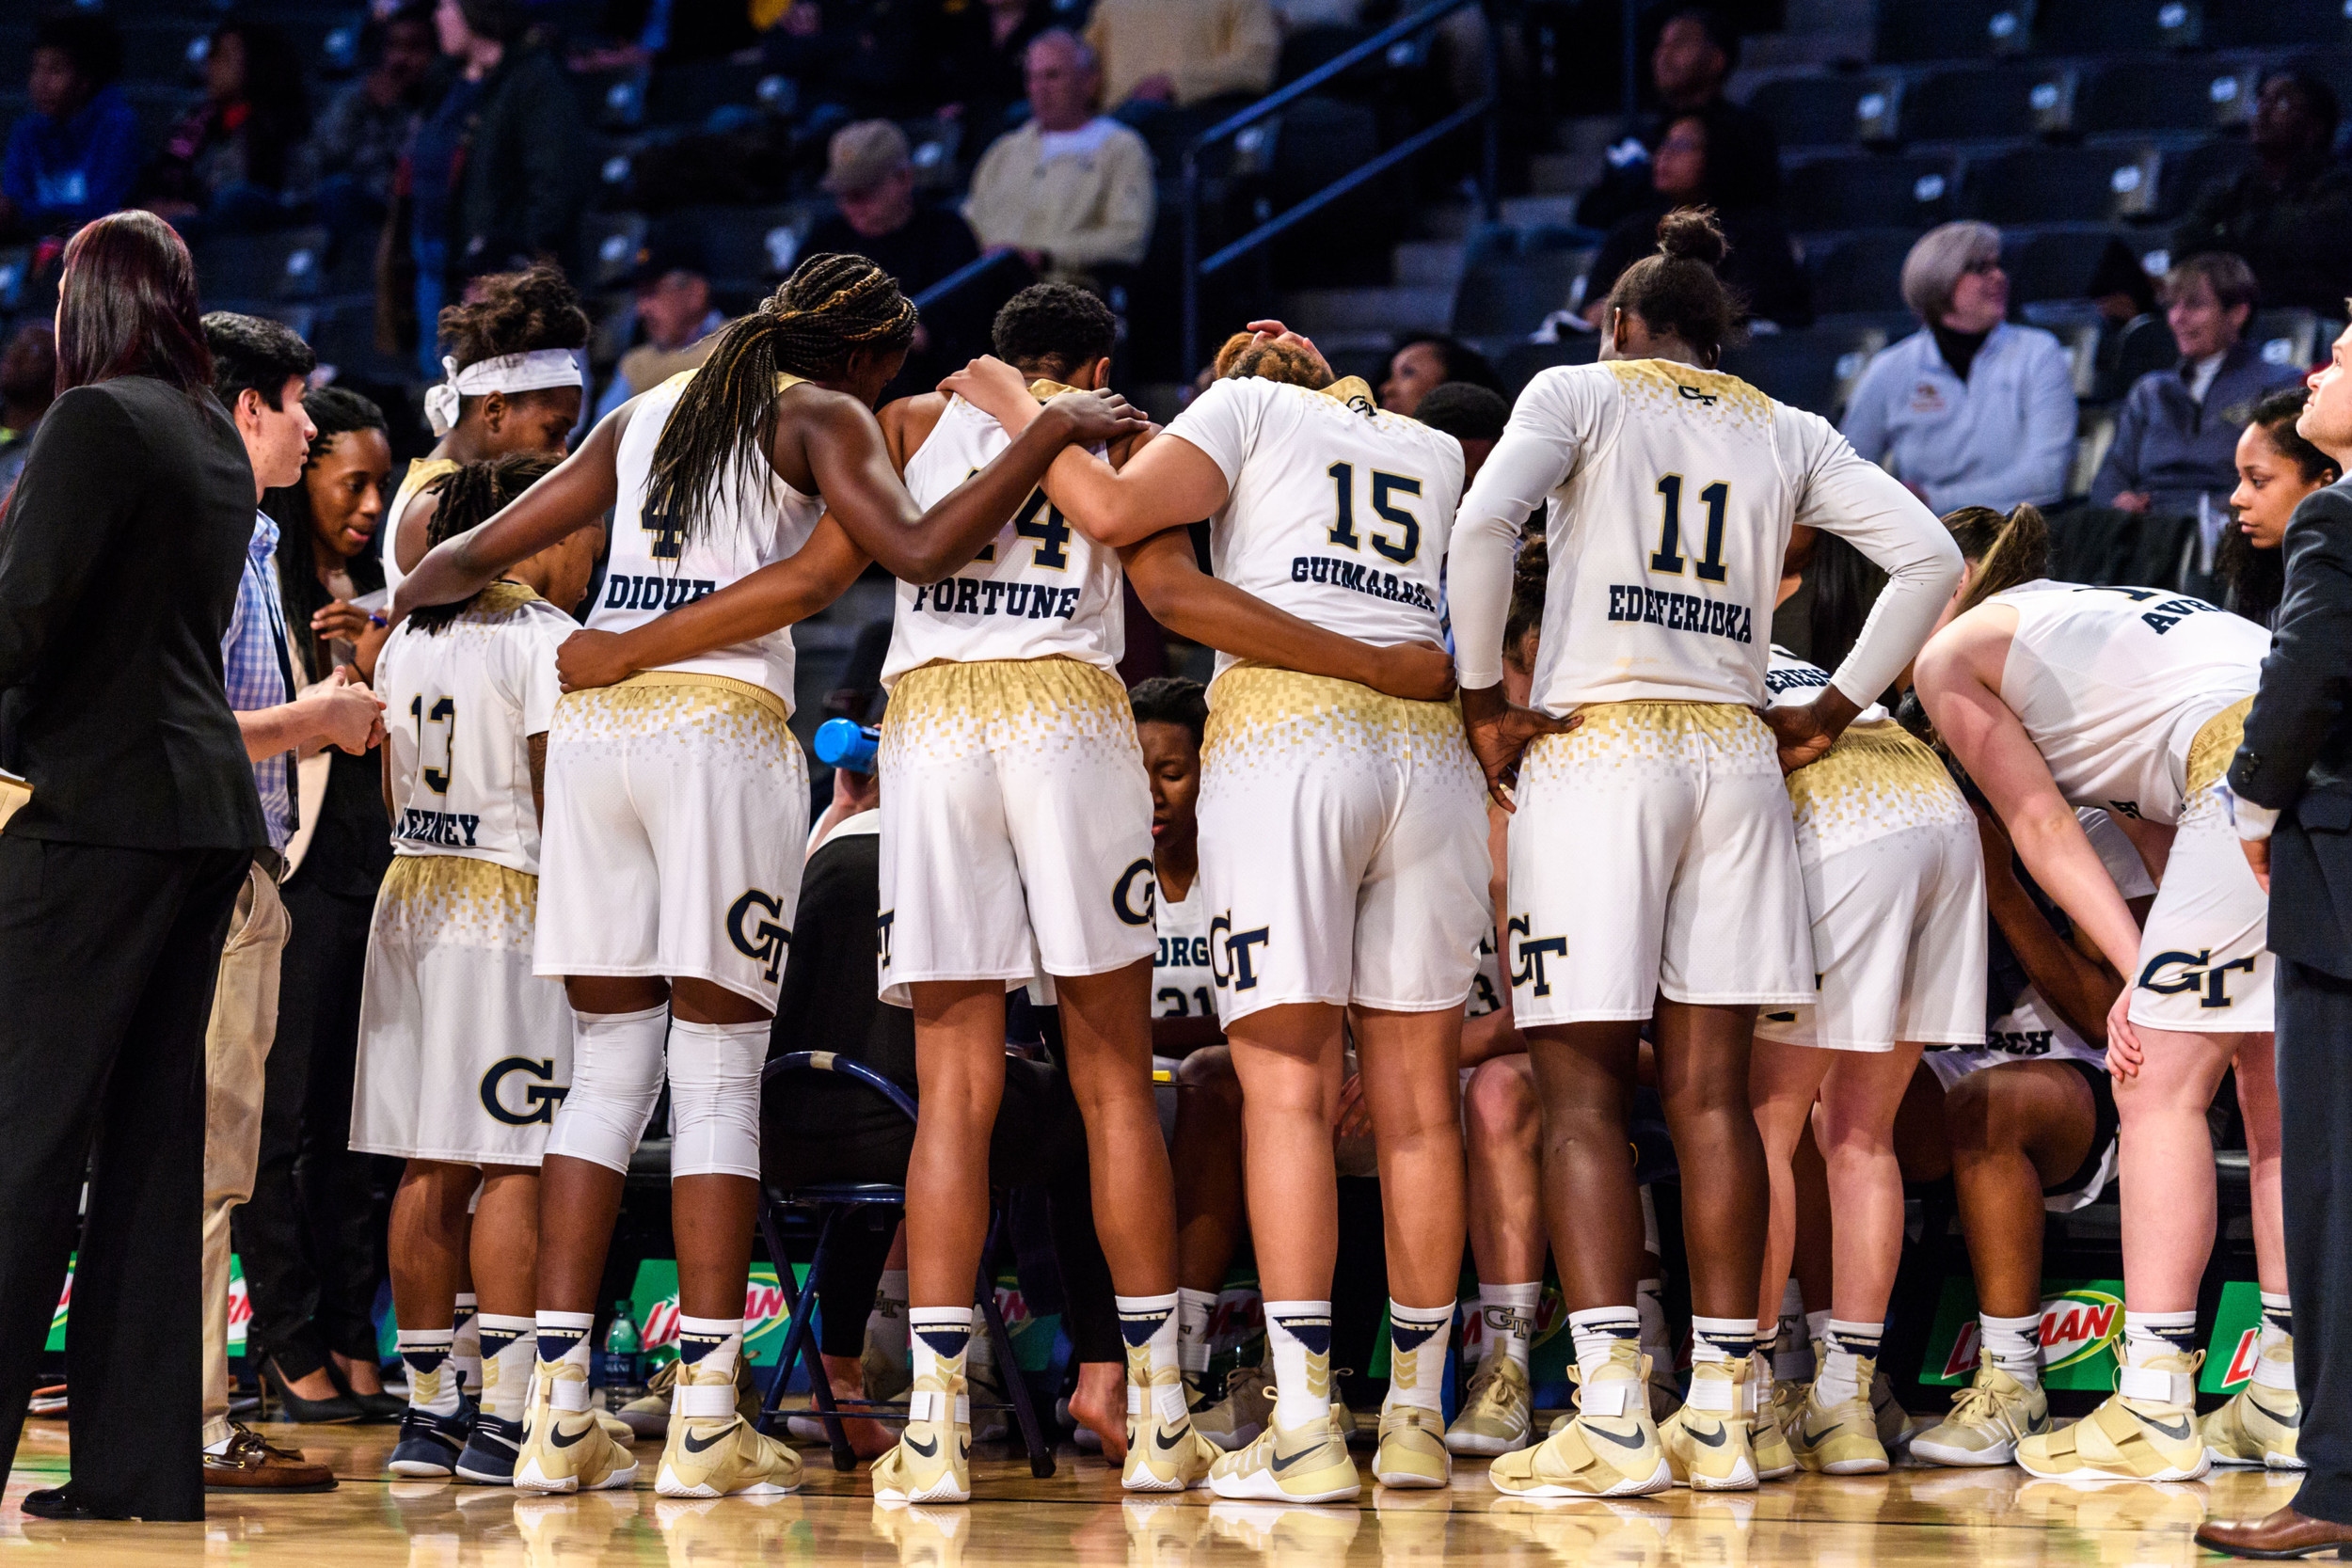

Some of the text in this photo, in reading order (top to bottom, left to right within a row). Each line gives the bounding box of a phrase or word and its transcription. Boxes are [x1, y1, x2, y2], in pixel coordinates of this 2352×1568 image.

[639, 472, 685, 562] 4
[1326, 459, 1423, 566] 15
[1648, 471, 1731, 585] 11
[913, 577, 1081, 621] FORTUNE
[1608, 584, 1752, 644] EDEFERIOKA
[394, 807, 481, 847] EENEY
[1210, 908, 1270, 994] GT
[1507, 911, 1569, 1000] GT
[2137, 947, 2258, 1010] GT
[1483, 1305, 1532, 1339] GT
